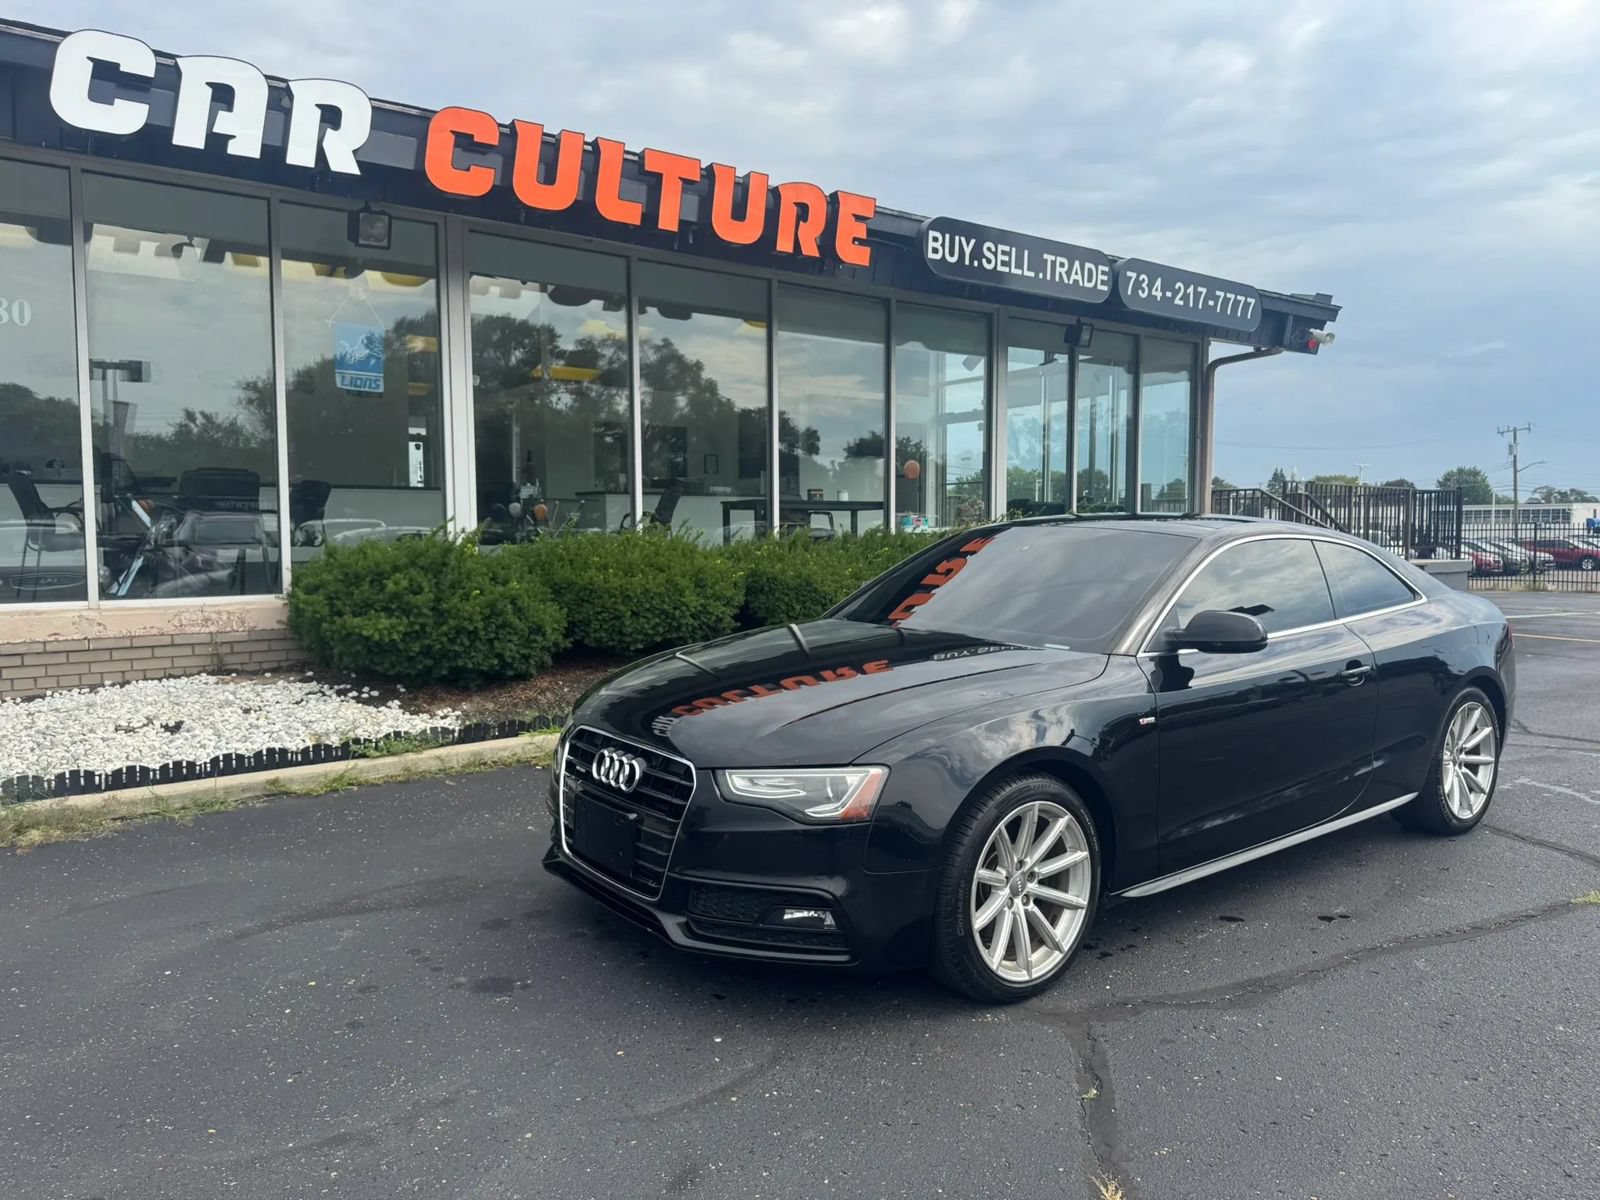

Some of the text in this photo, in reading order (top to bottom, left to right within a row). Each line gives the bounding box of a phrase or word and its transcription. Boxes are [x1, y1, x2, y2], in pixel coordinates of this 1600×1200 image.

[49, 28, 877, 267] CAR CULTURE
[1125, 270, 1256, 320] 734-217-7777
